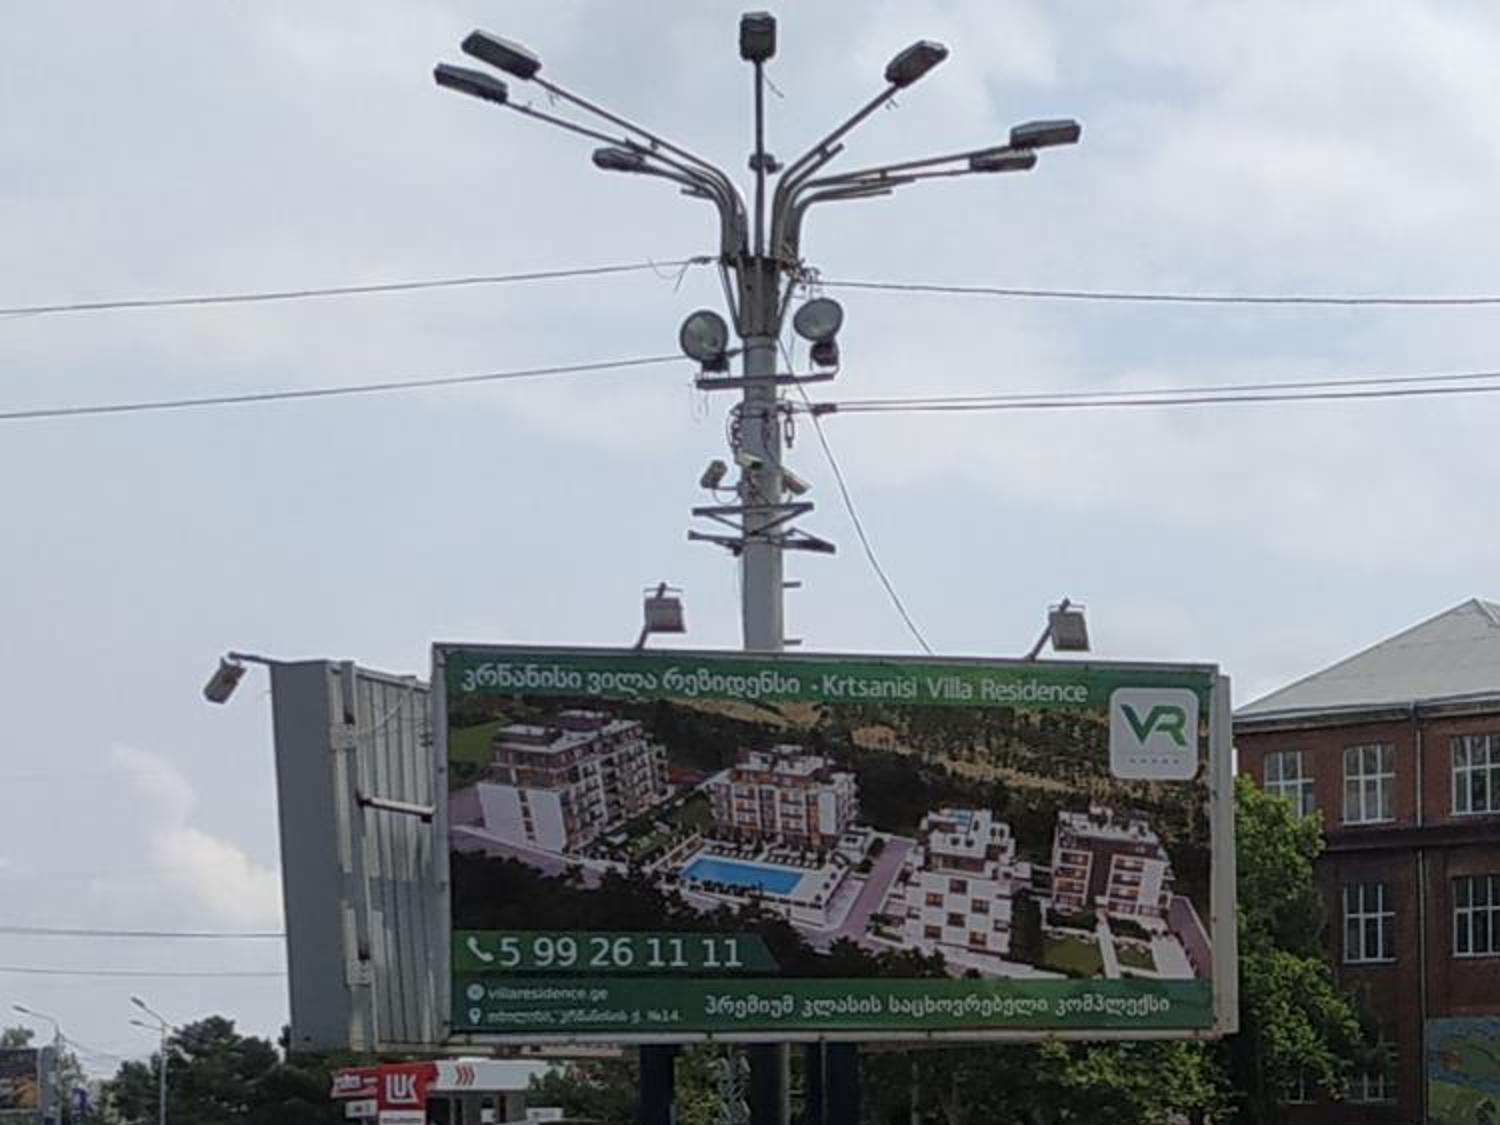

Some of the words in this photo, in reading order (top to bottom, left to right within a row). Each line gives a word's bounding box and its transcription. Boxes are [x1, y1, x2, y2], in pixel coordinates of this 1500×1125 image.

[461, 662, 582, 692] კრწანისი
[587, 670, 657, 696] ვილა
[662, 666, 801, 699] რეზიდენსი
[822, 674, 918, 699] Krtsanisi
[927, 677, 973, 700] Villa
[981, 678, 1088, 703] Residence
[1119, 703, 1189, 747] VR
[500, 936, 521, 967] 5
[533, 936, 577, 967] 99
[589, 937, 634, 967] 26
[646, 938, 689, 967] 11
[702, 938, 744, 968] 11
[487, 985, 609, 1003] villaresidence.ge
[704, 994, 795, 1018] პრემიუმ
[801, 994, 883, 1018] კლასის
[888, 993, 1050, 1018] საცხოვრებელი
[1055, 993, 1171, 1017] კომპლექსი
